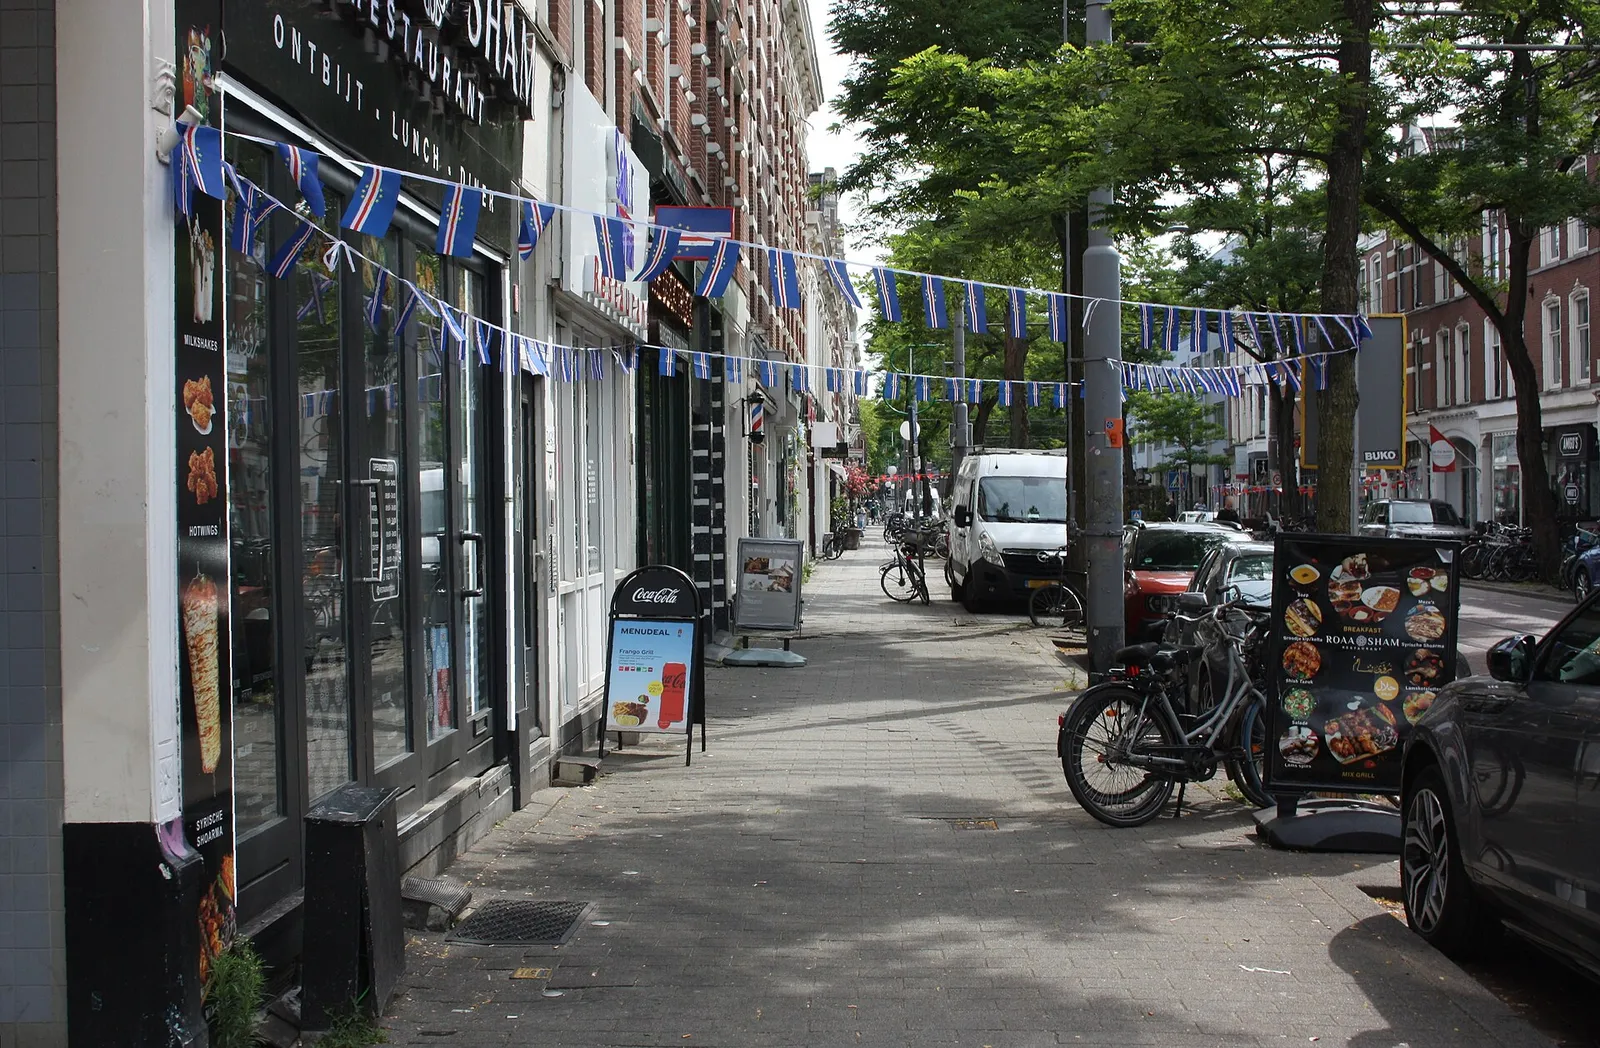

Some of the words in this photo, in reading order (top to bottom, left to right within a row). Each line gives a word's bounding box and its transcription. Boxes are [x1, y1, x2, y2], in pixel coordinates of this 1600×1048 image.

[350, 0, 485, 126] ESTAURANT
[273, 14, 364, 111] ONTBIJT
[392, 110, 440, 171] LUNCH
[183, 334, 219, 351] MILKSHAKES
[189, 524, 219, 537] HOTWINGS
[632, 587, 680, 604] Coca-Cola
[620, 627, 670, 636] MENUDEAL
[1343, 626, 1382, 635] BREAKFAST
[1326, 635, 1355, 645] ROAA
[1367, 637, 1400, 648] SHAM
[196, 810, 223, 831] SYRISCHE
[196, 826, 224, 847] SHOARMA
